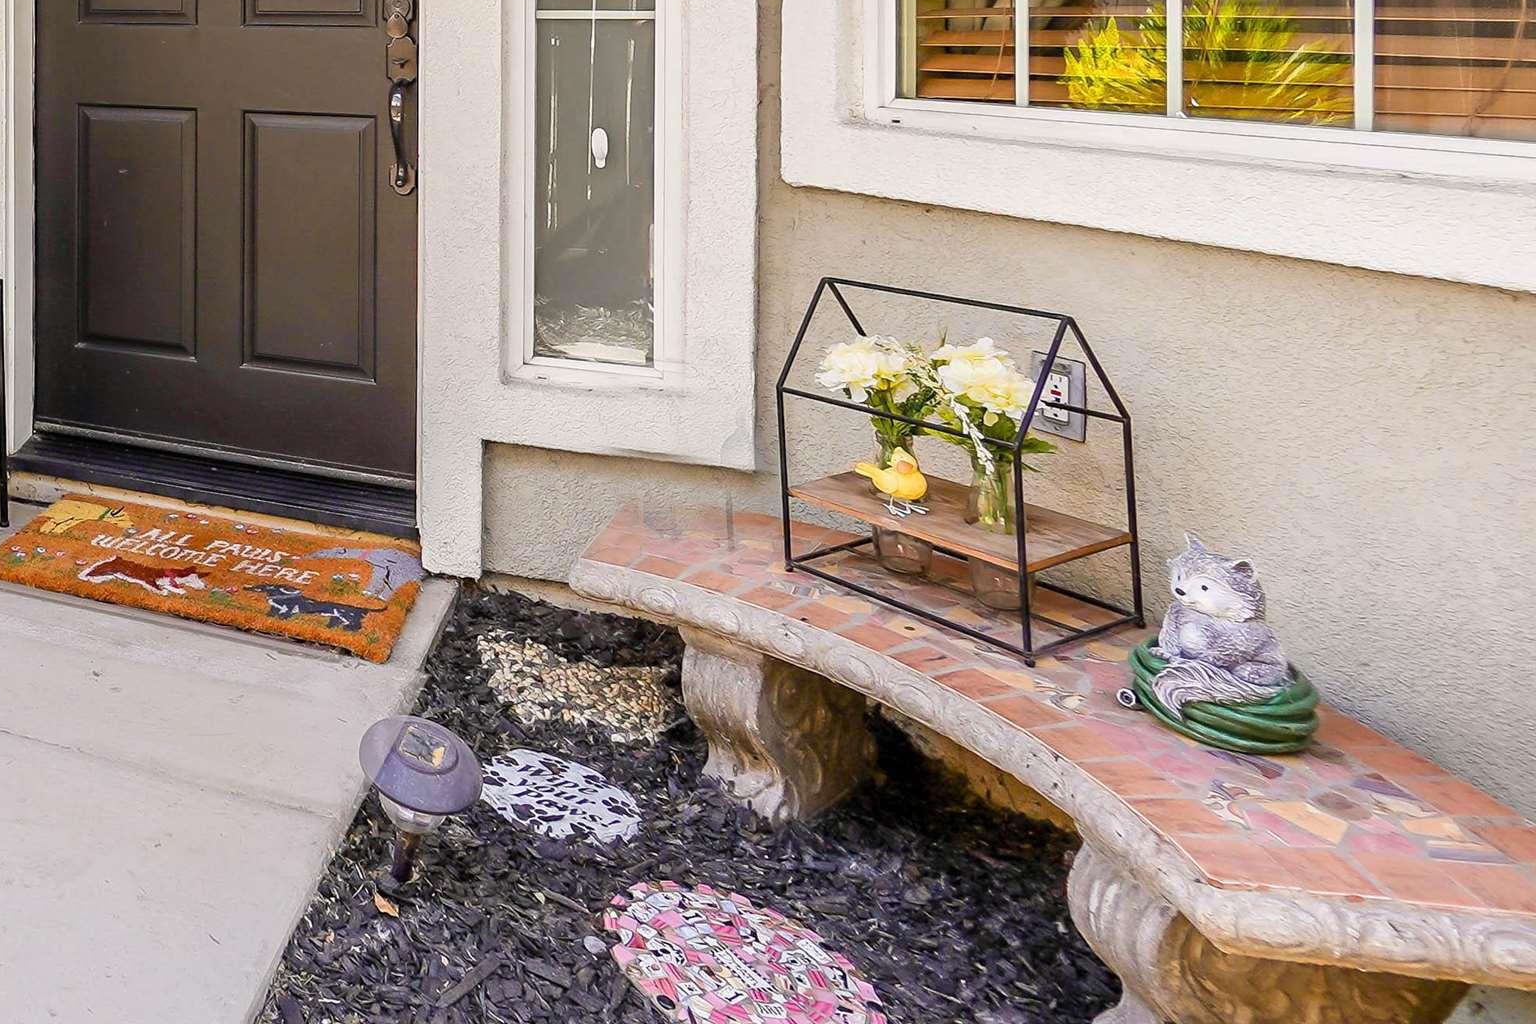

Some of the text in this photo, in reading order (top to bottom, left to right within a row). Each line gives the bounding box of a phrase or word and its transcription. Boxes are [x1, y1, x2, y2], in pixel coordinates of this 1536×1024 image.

[137, 528, 195, 547] ALL
[90, 534, 320, 585] WELCOME HERE
[508, 778, 596, 805] your
[517, 764, 599, 795] Wipe
